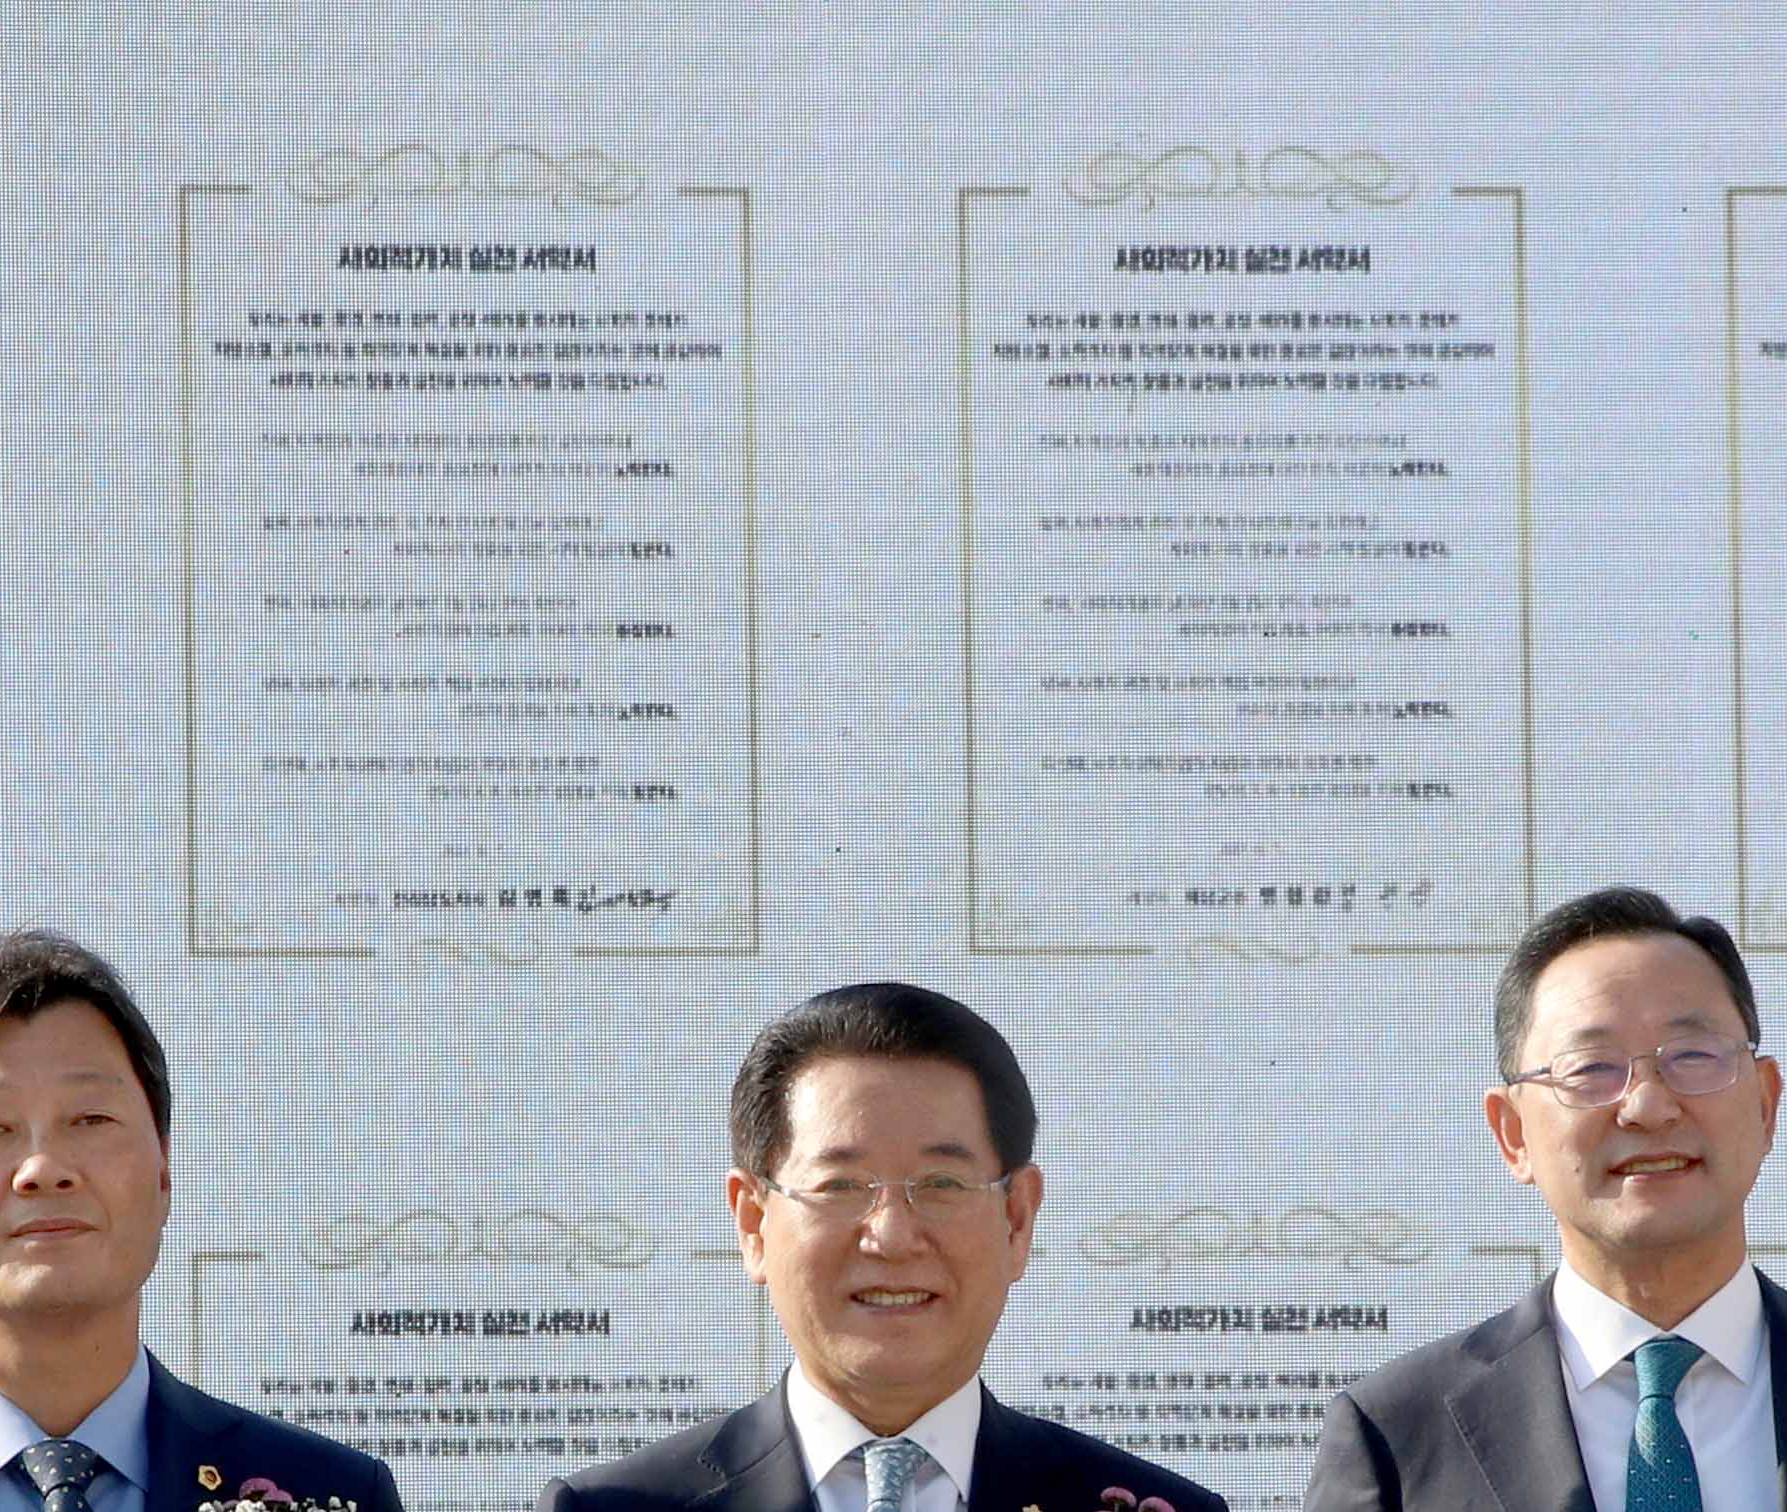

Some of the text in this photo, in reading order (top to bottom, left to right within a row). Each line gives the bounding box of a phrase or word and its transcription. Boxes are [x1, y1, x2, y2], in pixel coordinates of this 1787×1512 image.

[336, 243, 597, 273] 사회적가치 실천 서약서
[1113, 245, 1371, 273] 사회적가치 실천 서약서
[350, 1309, 610, 1337] 사회적가치 실천 서약서
[1130, 1304, 1388, 1333] 사회적가치 실천 서약서
